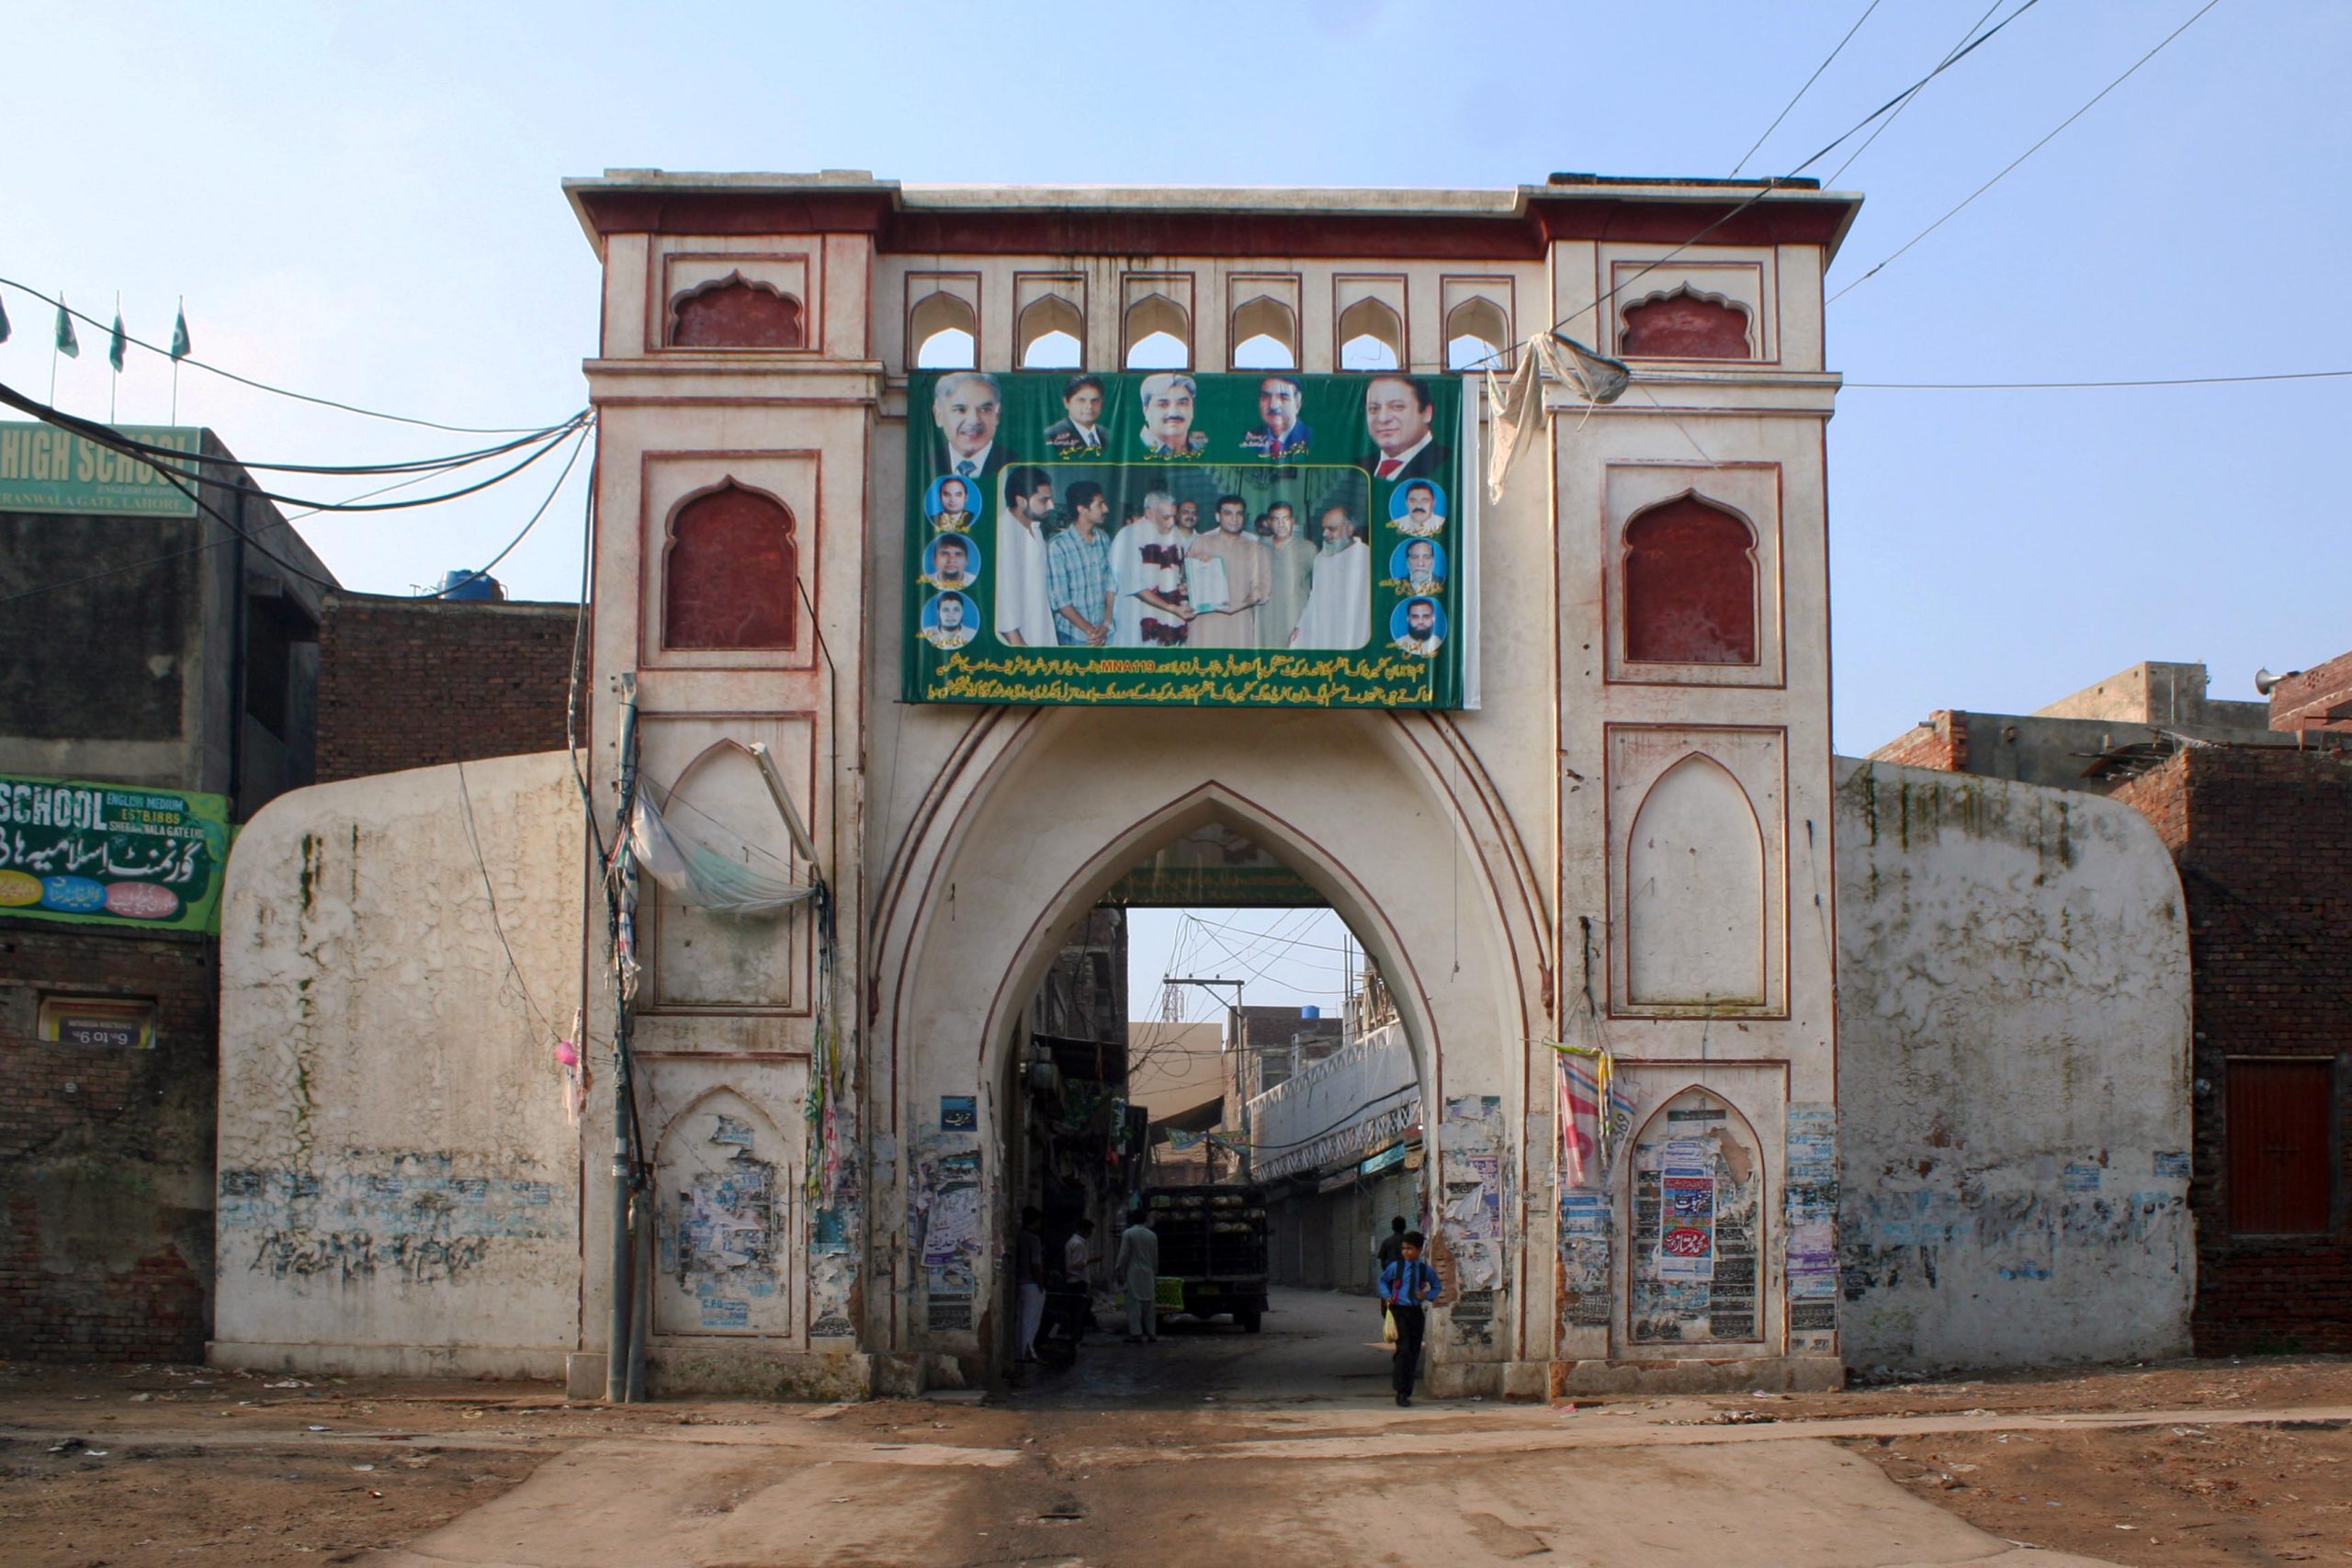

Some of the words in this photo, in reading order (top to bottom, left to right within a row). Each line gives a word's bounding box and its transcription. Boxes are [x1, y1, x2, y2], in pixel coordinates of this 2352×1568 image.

[1, 429, 71, 481] HIGH
[77, 433, 187, 487] SCHOOL
[1101, 659, 1156, 674] MNA119
[0, 783, 107, 831] SCHOOL
[147, 796, 184, 811] MEDIUM
